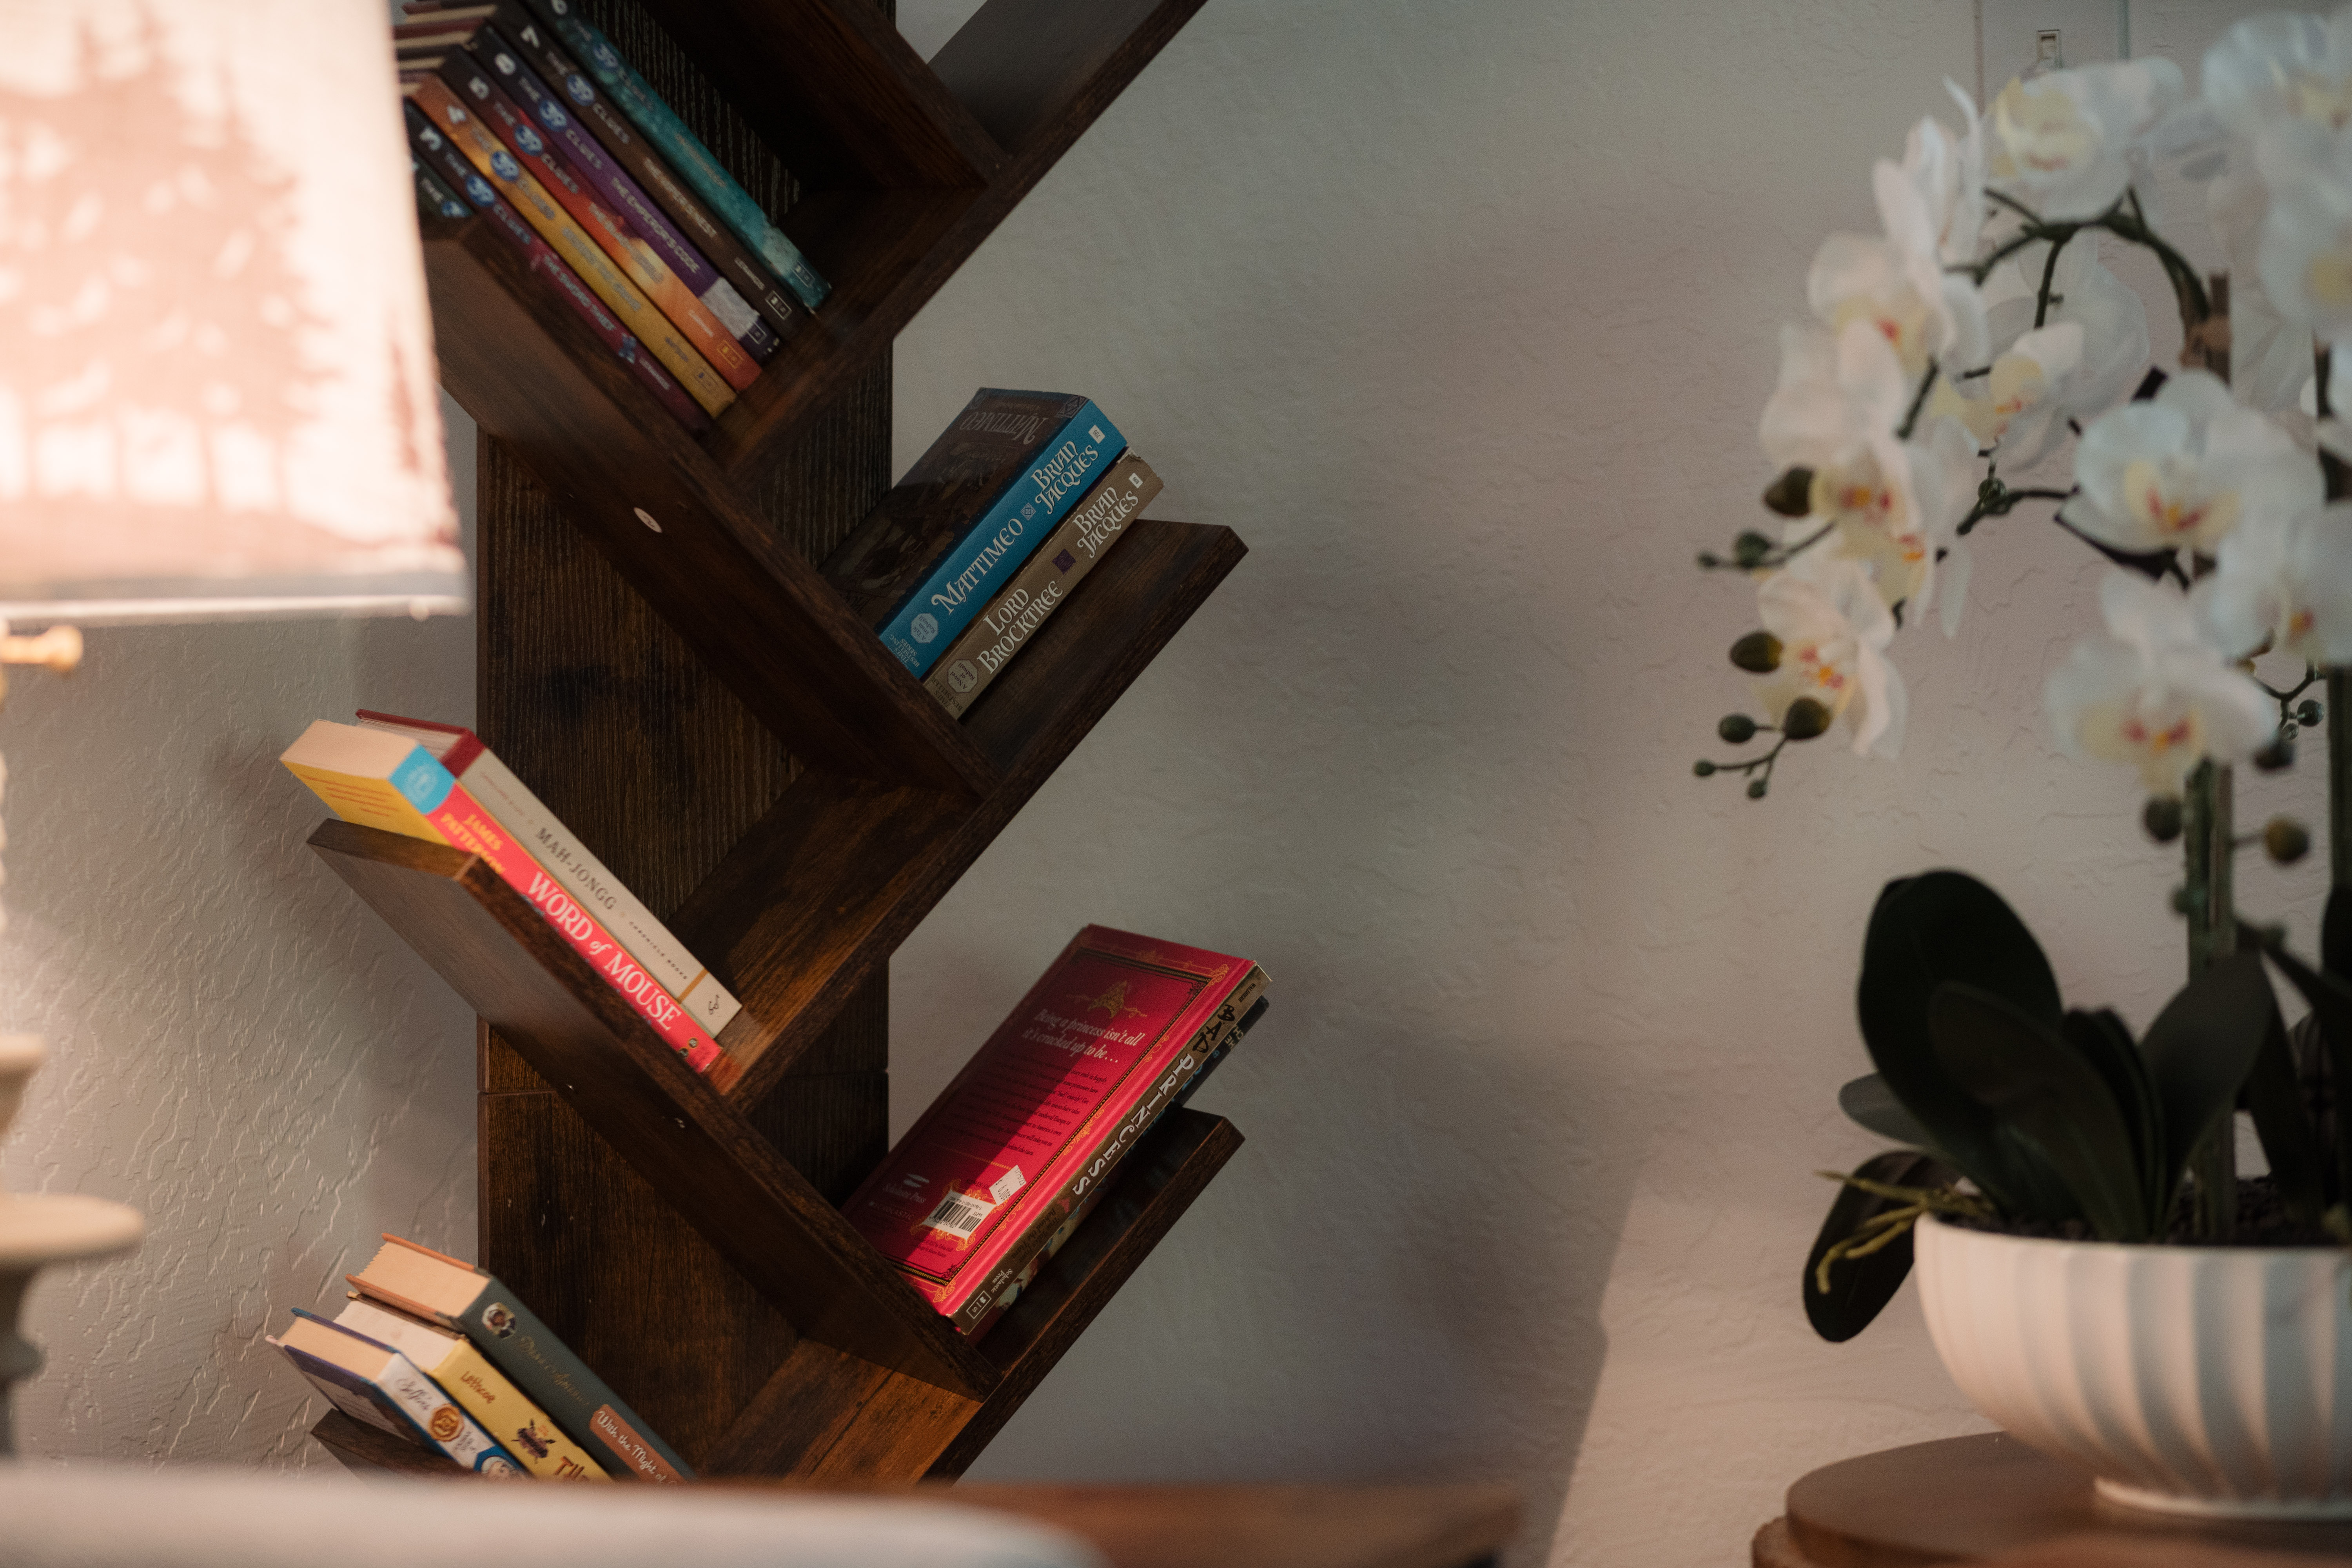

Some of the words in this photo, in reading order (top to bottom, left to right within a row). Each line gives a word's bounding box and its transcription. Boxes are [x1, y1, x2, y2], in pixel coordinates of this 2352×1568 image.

[520, 26, 540, 47] 7
[566, 73, 598, 105] 39
[592, 103, 630, 143] CLUES
[538, 99, 570, 131] 39
[564, 129, 603, 169] CLUES
[490, 149, 523, 182] 39
[513, 123, 546, 157] 39
[540, 154, 579, 194] CLUES
[464, 174, 498, 208] 39
[493, 205, 530, 244] CLUES
[1031, 441, 1078, 491] BRIAN
[1035, 445, 1098, 514] JACQUES
[1073, 487, 1119, 535] BRIAN
[1077, 491, 1138, 558] JACQUES
[931, 518, 1024, 615] MATTIMEO
[918, 623, 929, 635] from
[919, 615, 936, 634] Redwall
[977, 581, 1063, 674] BROCKTREE
[983, 589, 1029, 636] LORD
[901, 638, 917, 656] SERIES
[913, 626, 922, 637] Tale
[889, 634, 920, 668] BESTSELLING
[893, 648, 909, 662] TIMES
[950, 671, 963, 686] Novel
[958, 662, 975, 681] Redwall
[931, 677, 963, 711] BESTSELLER
[463, 814, 503, 851] JAMES
[535, 827, 617, 910] MAH-JONGG
[528, 871, 593, 940] WORD
[588, 940, 612, 955] of
[603, 951, 682, 1031] MOUSE
[1238, 983, 1256, 1002] WALDHERR
[1036, 1034, 1078, 1049] cracked
[1069, 1042, 1086, 1057] up
[1083, 1045, 1096, 1055] to
[1062, 1018, 1105, 1036] princess
[1103, 1027, 1128, 1042] isn't
[1124, 1032, 1146, 1046] all
[1051, 1116, 1069, 1125] Europe
[1072, 1053, 1194, 1195] PRINCESS
[989, 1267, 1014, 1294] Scholastic
[991, 1269, 1005, 1285] Press
[596, 1411, 619, 1438] With
[618, 1434, 631, 1451] the
[631, 1444, 657, 1474] Might
